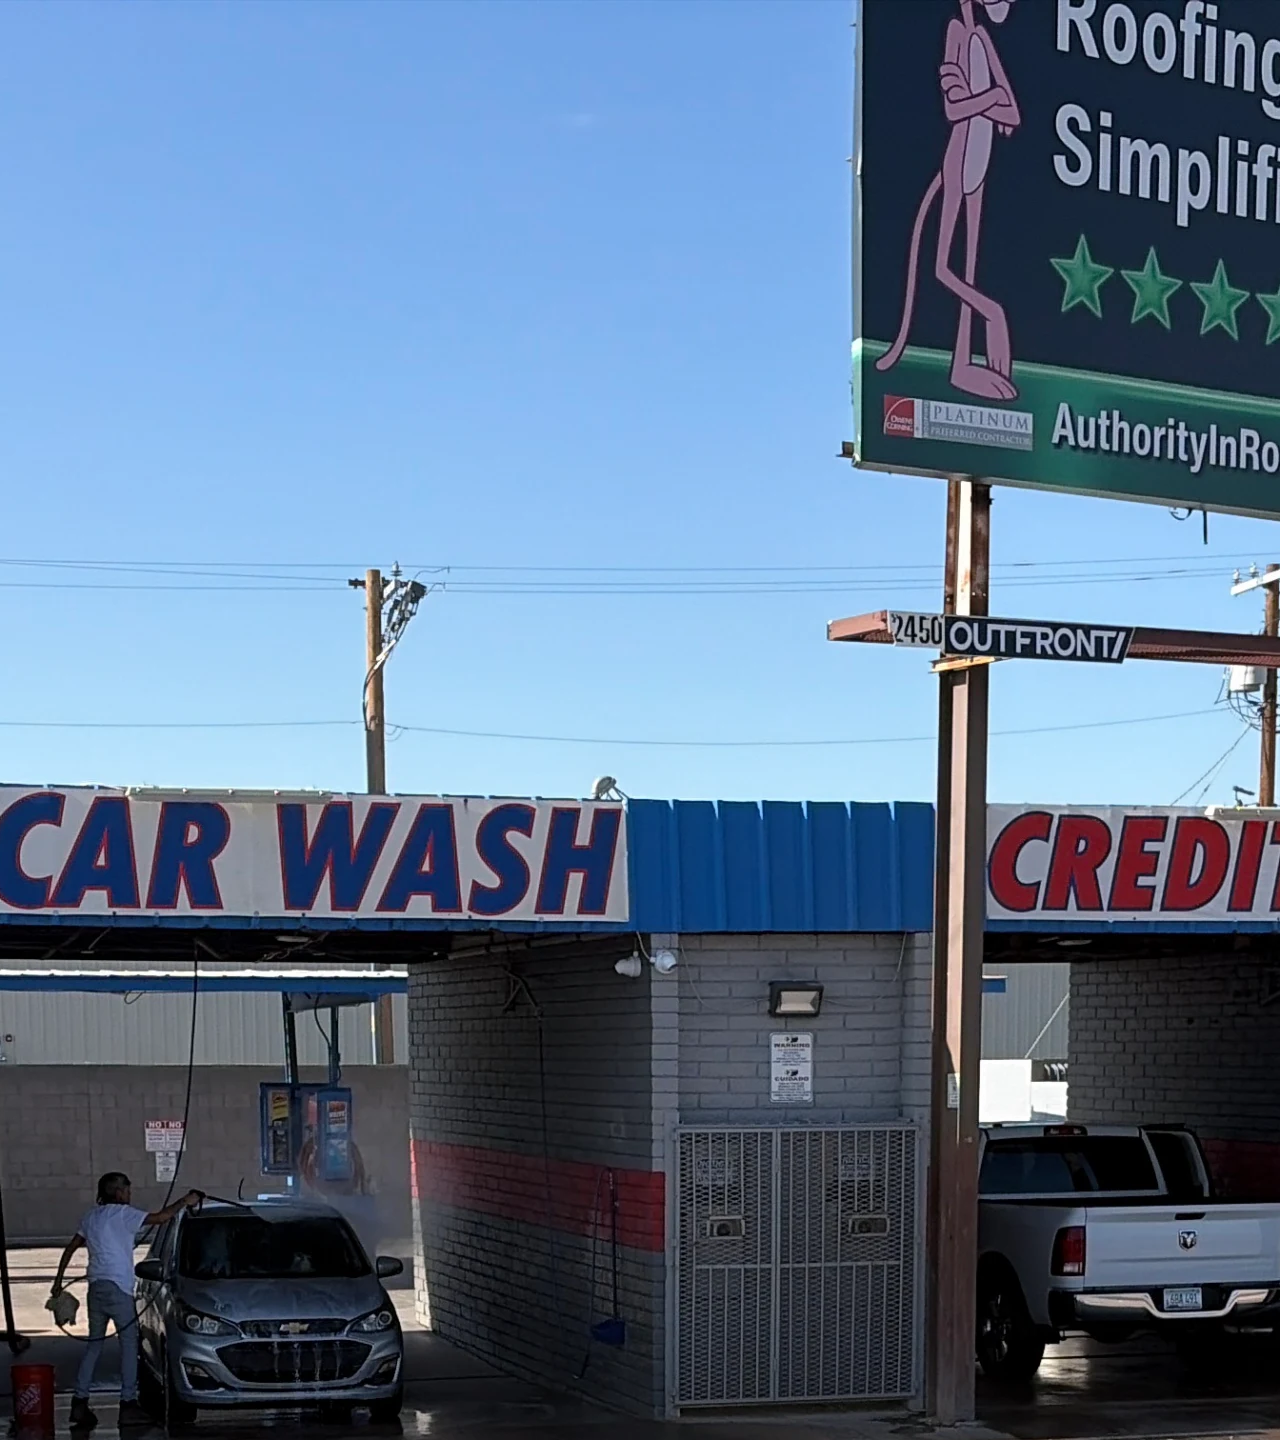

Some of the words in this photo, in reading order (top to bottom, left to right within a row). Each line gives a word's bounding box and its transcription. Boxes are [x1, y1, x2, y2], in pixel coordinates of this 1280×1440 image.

[933, 405, 1030, 431] PLATINUM
[930, 426, 976, 440] PREFERRED
[894, 614, 943, 644] 2450
[277, 802, 622, 916] WASH
